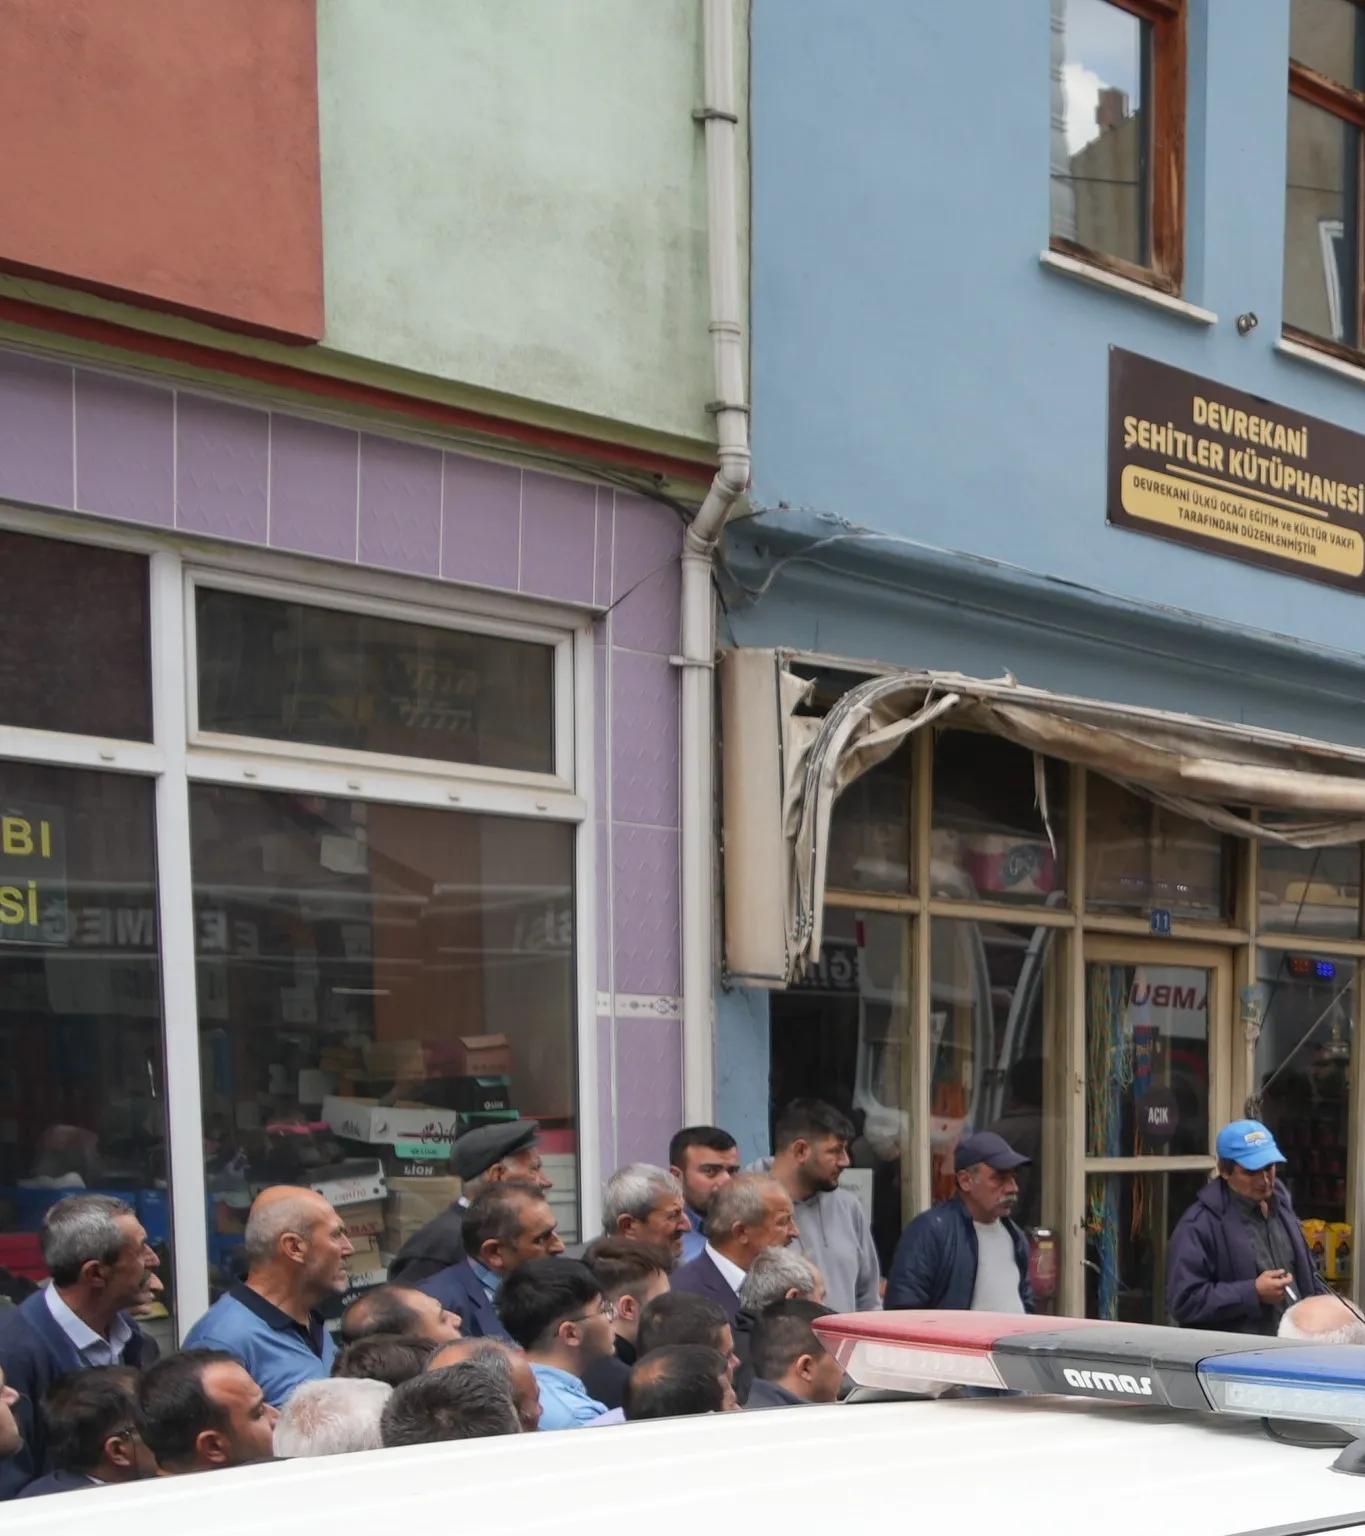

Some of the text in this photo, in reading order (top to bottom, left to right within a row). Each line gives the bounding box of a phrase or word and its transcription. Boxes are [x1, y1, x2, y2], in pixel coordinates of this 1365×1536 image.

[1193, 395, 1308, 460] DEVREKANİ
[1124, 414, 1365, 516] ŞEHİTLER KÜTÜPHANESİ
[1133, 475, 1355, 550] DEVREKANİ ÜLKÜ OCAĞI EĞİTİM ve KÜLTÜR VAKFI
[1178, 506, 1317, 557] TARAFINDAN DÜZENLENMİŞTİR
[1148, 1105, 1169, 1126] AÇIK
